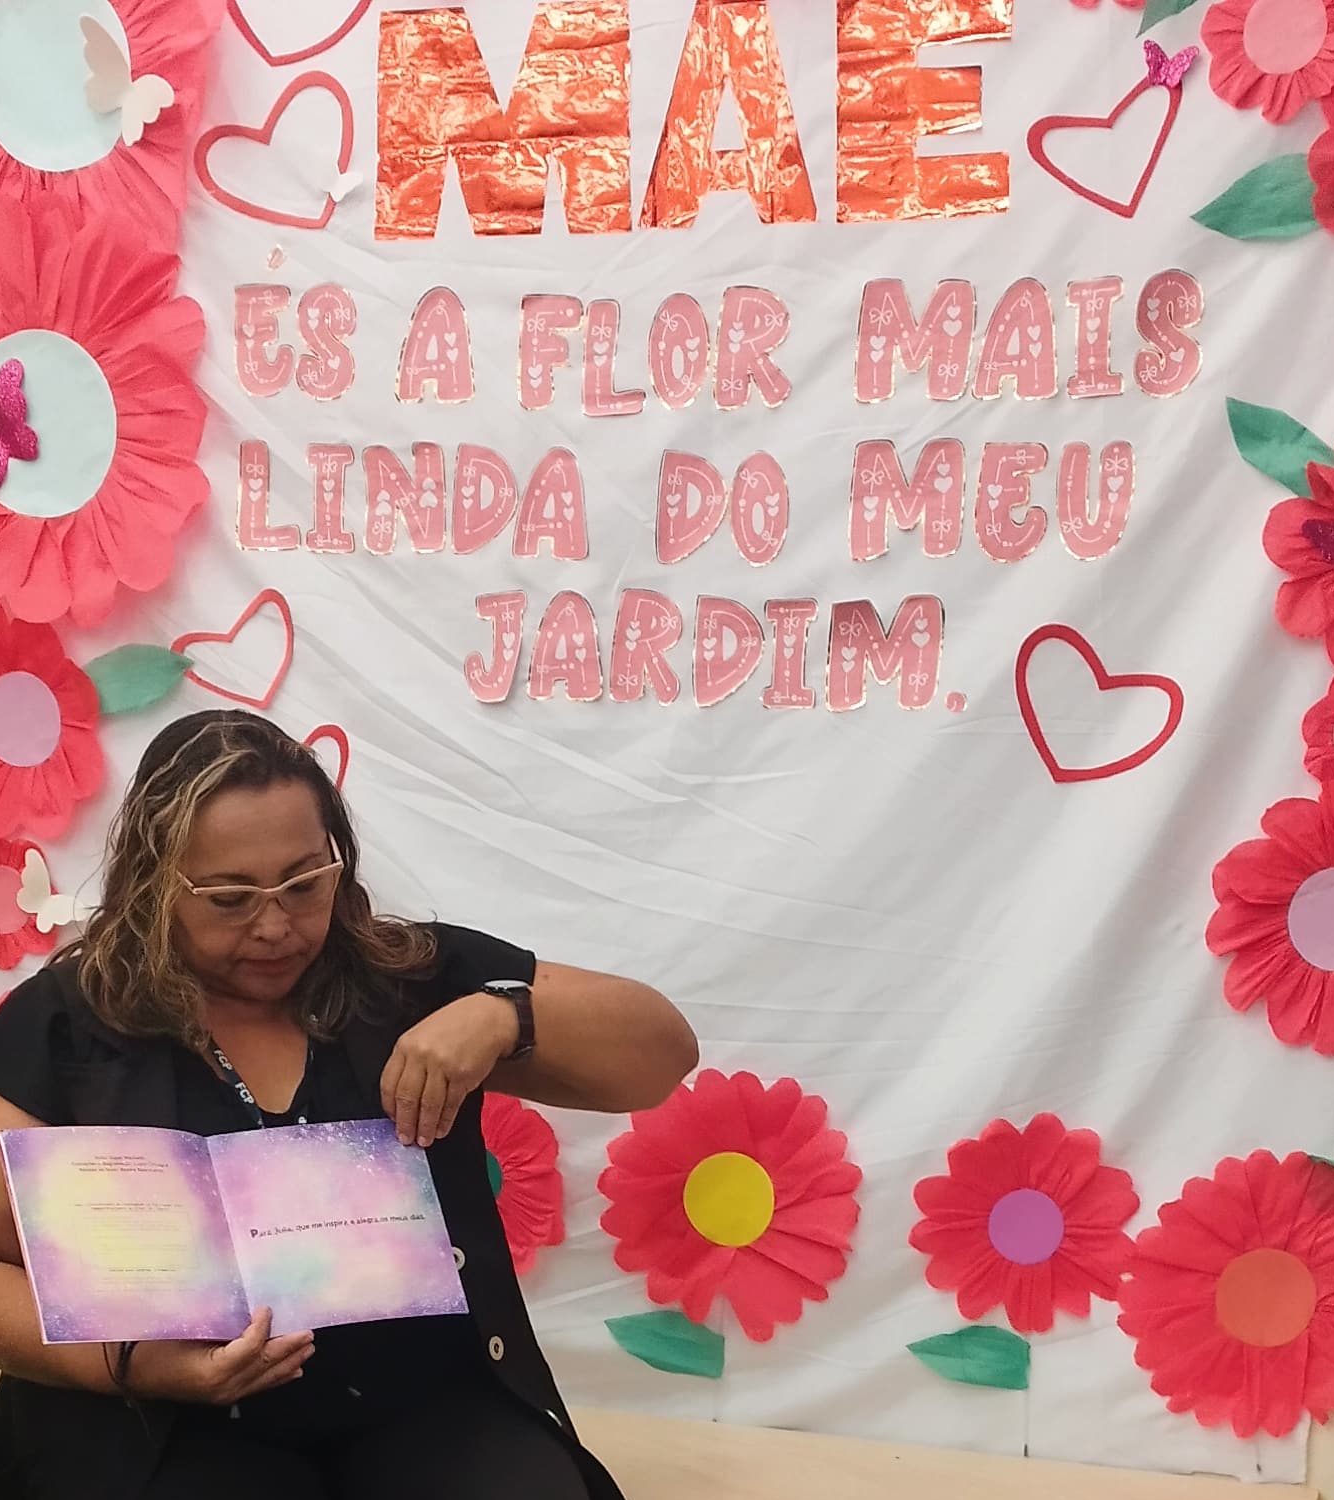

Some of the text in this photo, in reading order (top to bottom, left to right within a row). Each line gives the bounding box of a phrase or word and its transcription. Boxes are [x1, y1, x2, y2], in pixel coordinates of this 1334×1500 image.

[394, 285, 476, 405] A
[517, 284, 792, 419] FLOR
[853, 267, 1207, 405] MAIS
[235, 438, 1136, 566] LINDA DO MEU
[462, 588, 969, 712] JARDIM.
[214, 1049, 233, 1070] FCP
[235, 1082, 255, 1104] FCP
